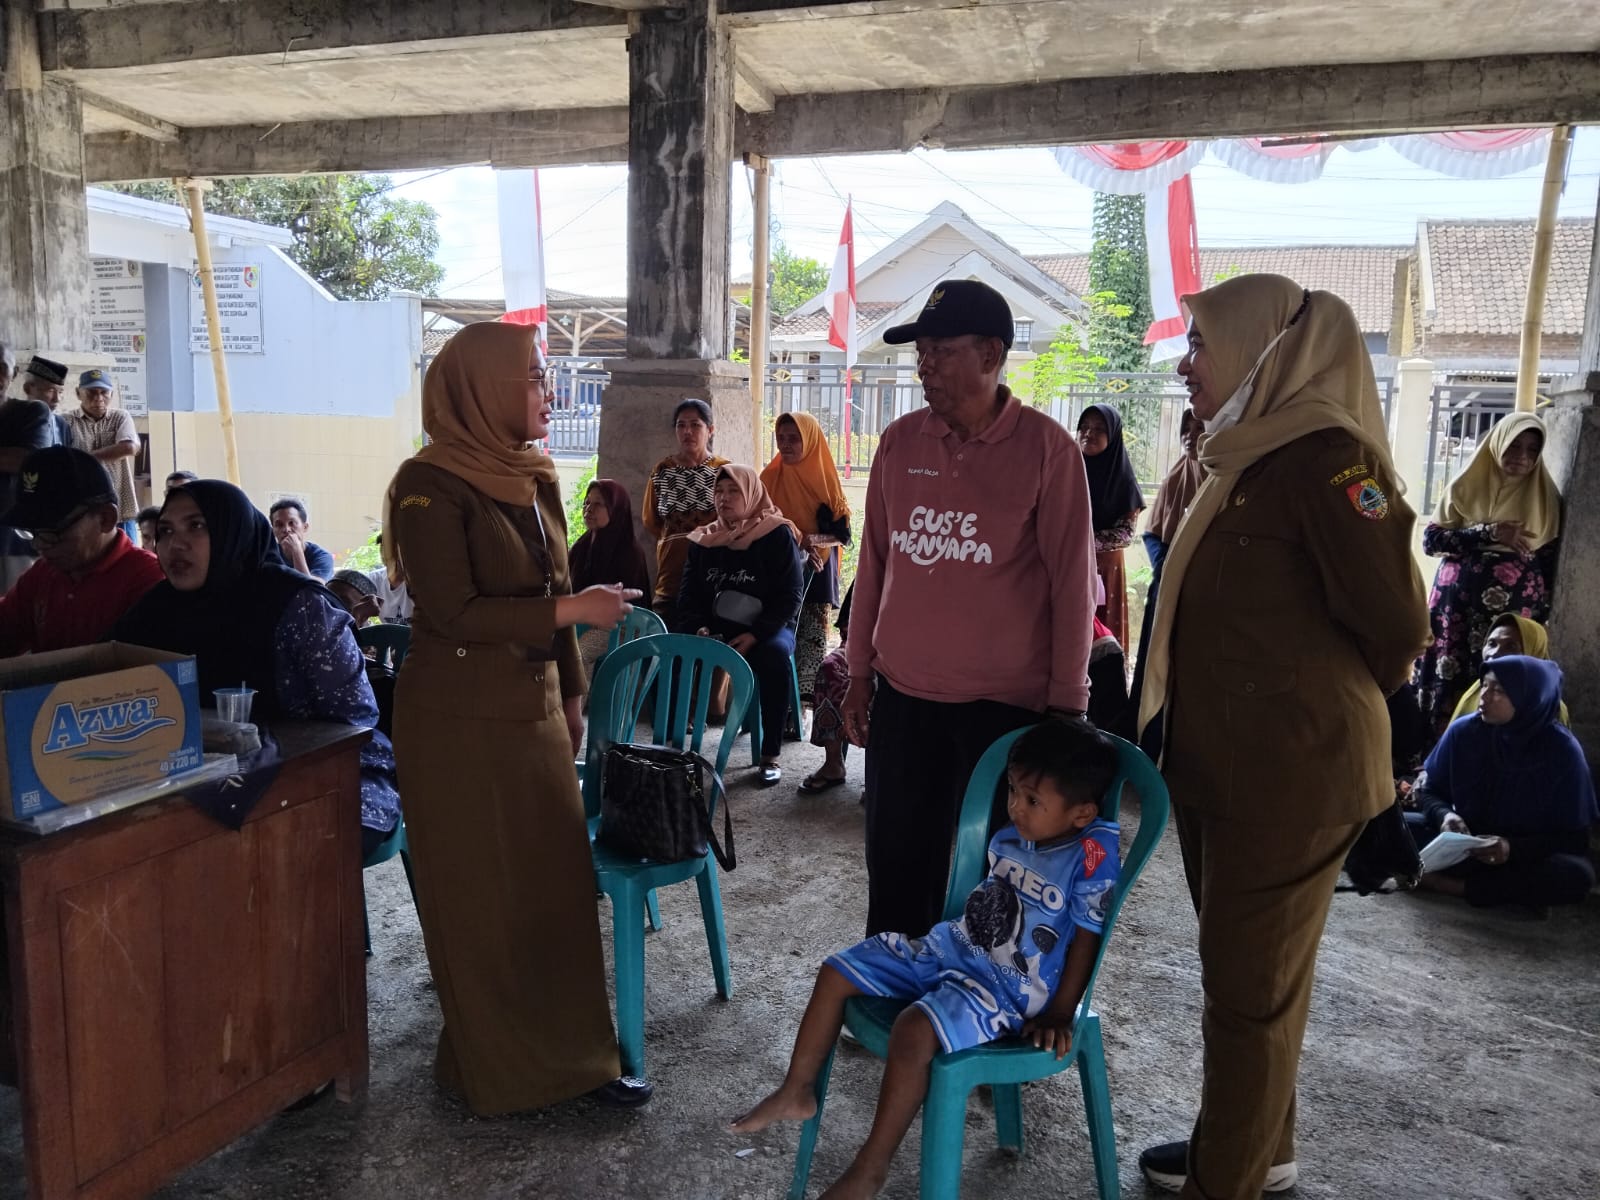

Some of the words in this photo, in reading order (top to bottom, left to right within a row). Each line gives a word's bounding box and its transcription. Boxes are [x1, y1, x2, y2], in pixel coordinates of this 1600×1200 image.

[909, 506, 977, 537] GUS'E
[891, 530, 993, 566] MENYAPA
[176, 755, 189, 769] 220
[22, 792, 41, 807] SNI
